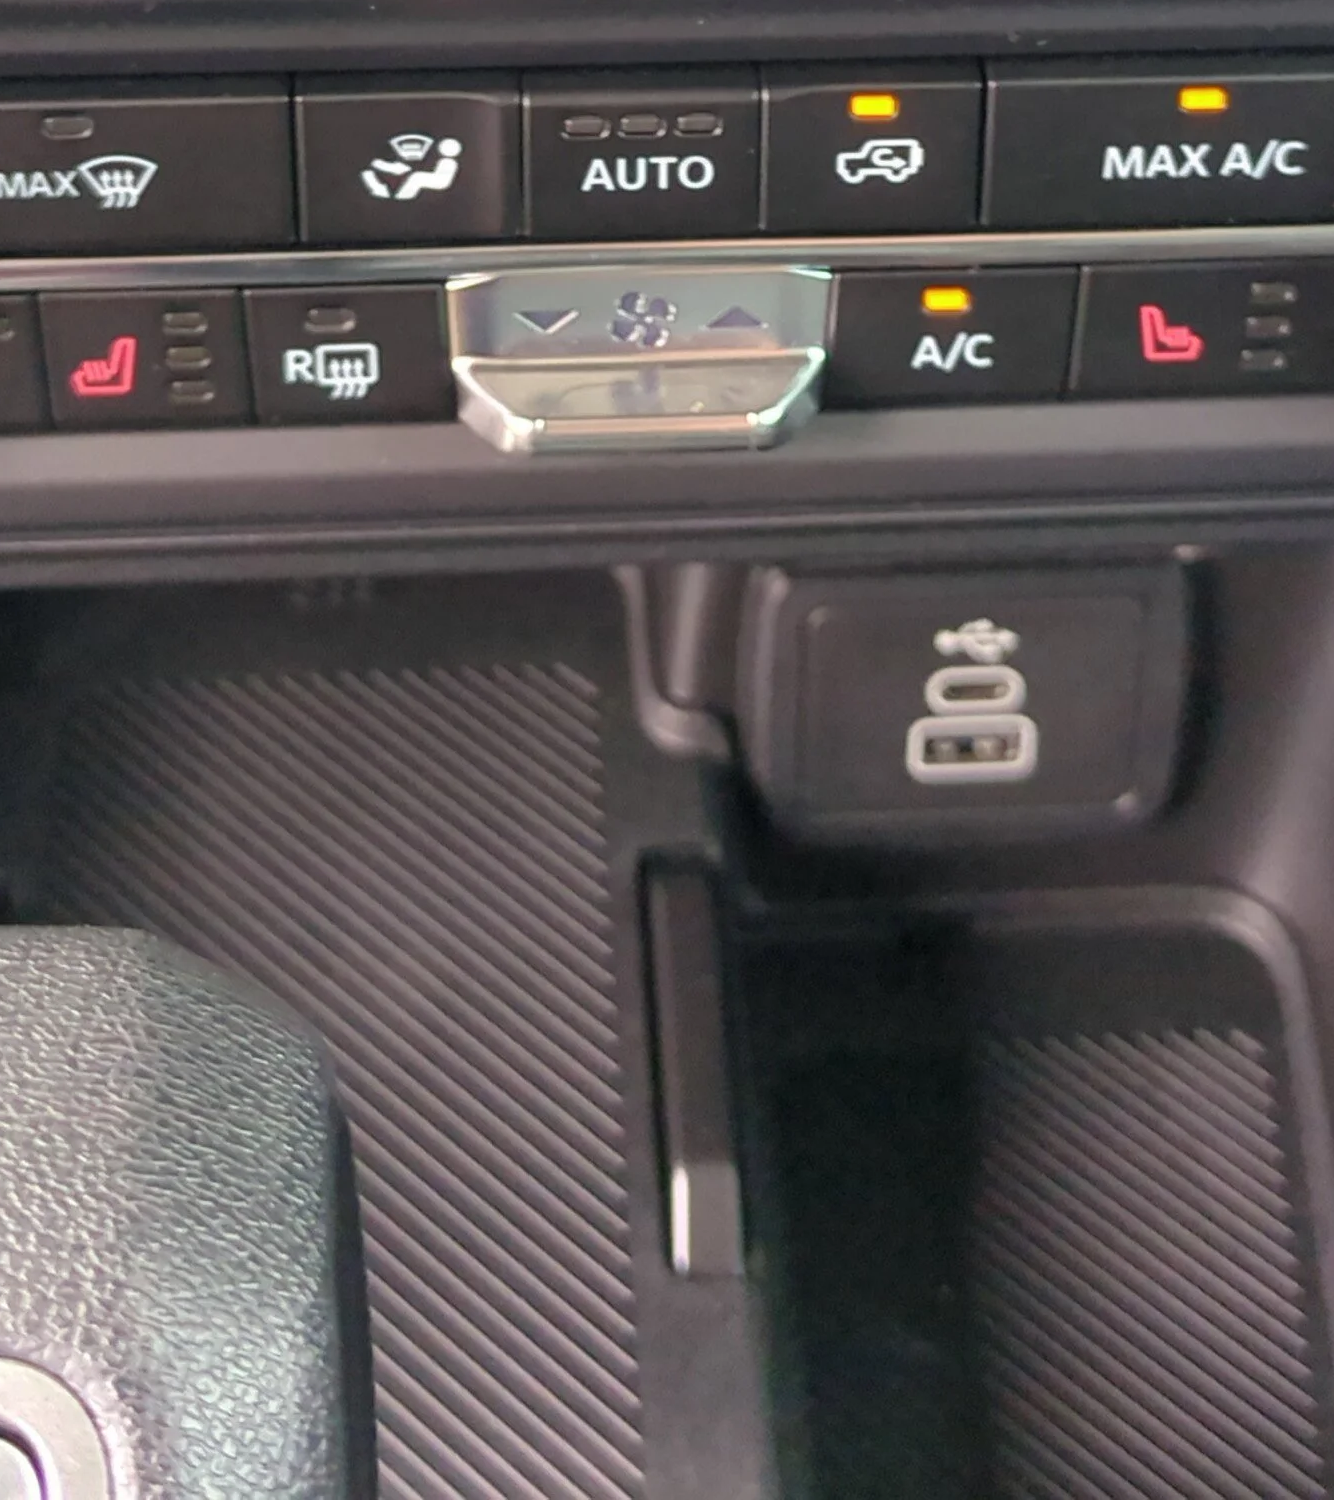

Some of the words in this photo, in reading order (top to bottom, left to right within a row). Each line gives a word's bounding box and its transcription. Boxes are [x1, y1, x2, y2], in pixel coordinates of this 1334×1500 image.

[581, 155, 715, 192] AUTO
[1101, 144, 1210, 180] MAX
[1219, 138, 1308, 180] A/C
[283, 349, 313, 382] R
[910, 332, 995, 372] A/C
